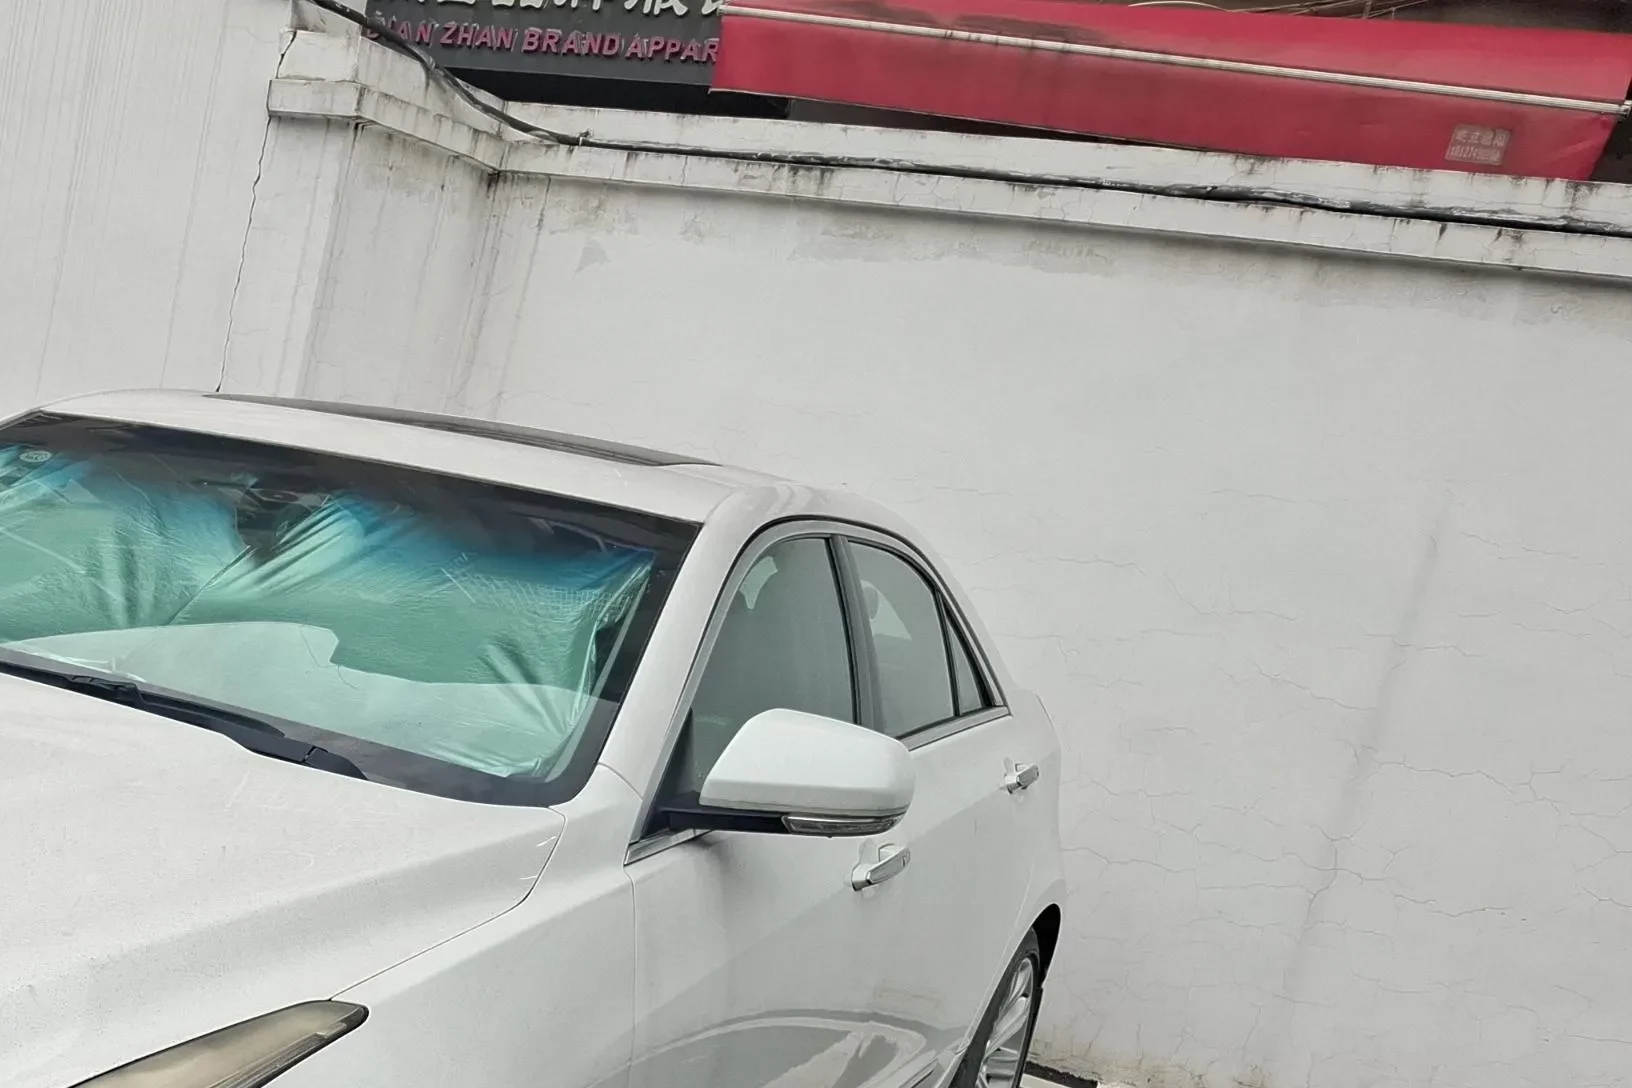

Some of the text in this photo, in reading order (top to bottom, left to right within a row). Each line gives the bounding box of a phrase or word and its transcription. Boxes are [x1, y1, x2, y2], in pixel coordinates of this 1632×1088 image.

[366, 10, 720, 62] IAN ZHAN BRAND APPAR
